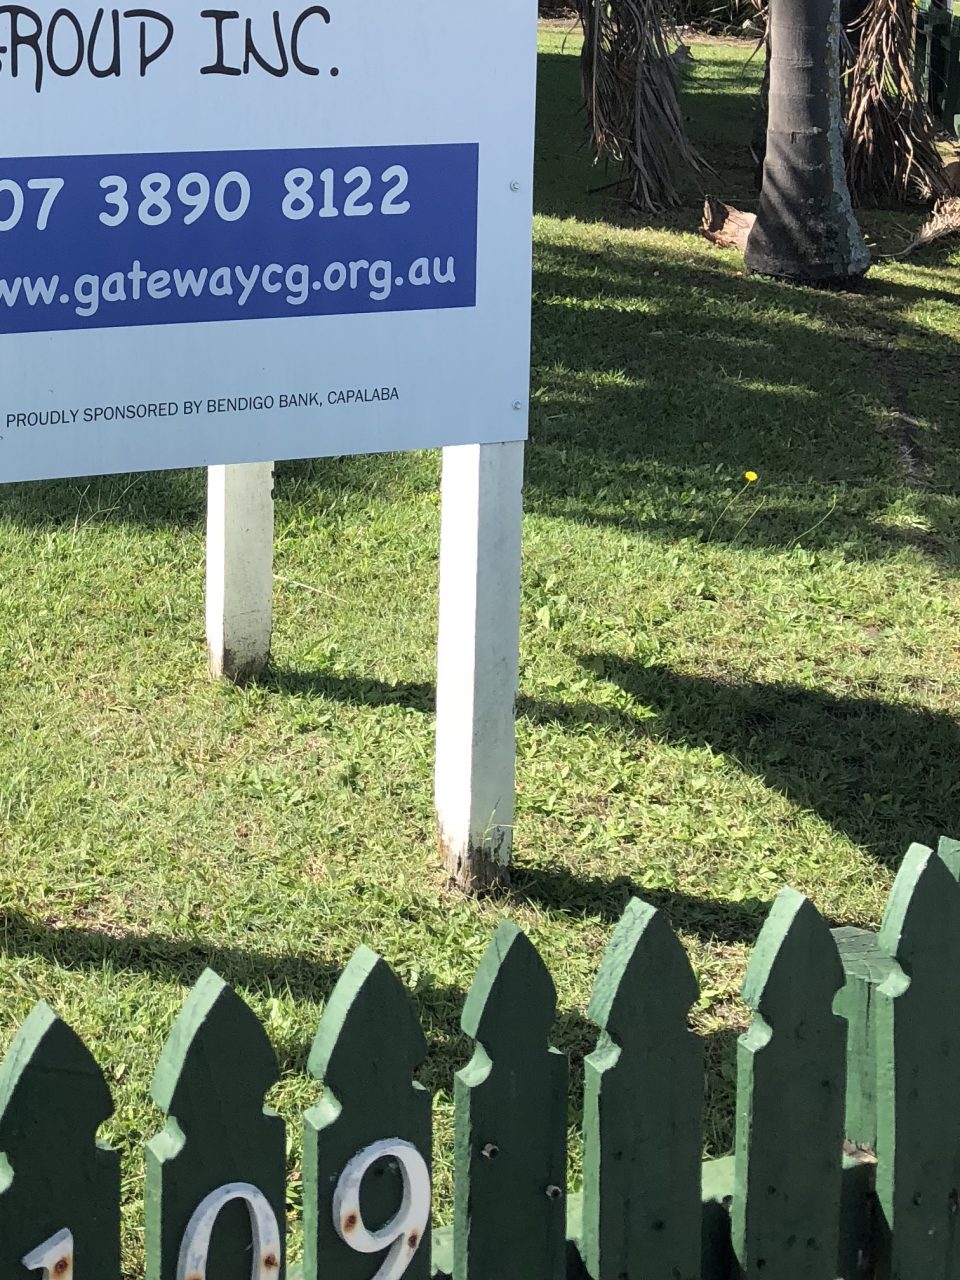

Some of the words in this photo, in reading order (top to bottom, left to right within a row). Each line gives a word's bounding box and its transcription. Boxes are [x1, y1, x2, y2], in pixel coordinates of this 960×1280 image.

[199, 5, 340, 78] INC.
[98, 171, 252, 227] 3890
[281, 164, 411, 220] 8122
[6, 408, 80, 429] PROUDLY
[82, 401, 179, 423] SPONSORED
[183, 399, 204, 415] BY
[206, 395, 275, 414] BENDIGO
[278, 392, 324, 409] BANK,
[327, 386, 400, 405] CAPALABA
